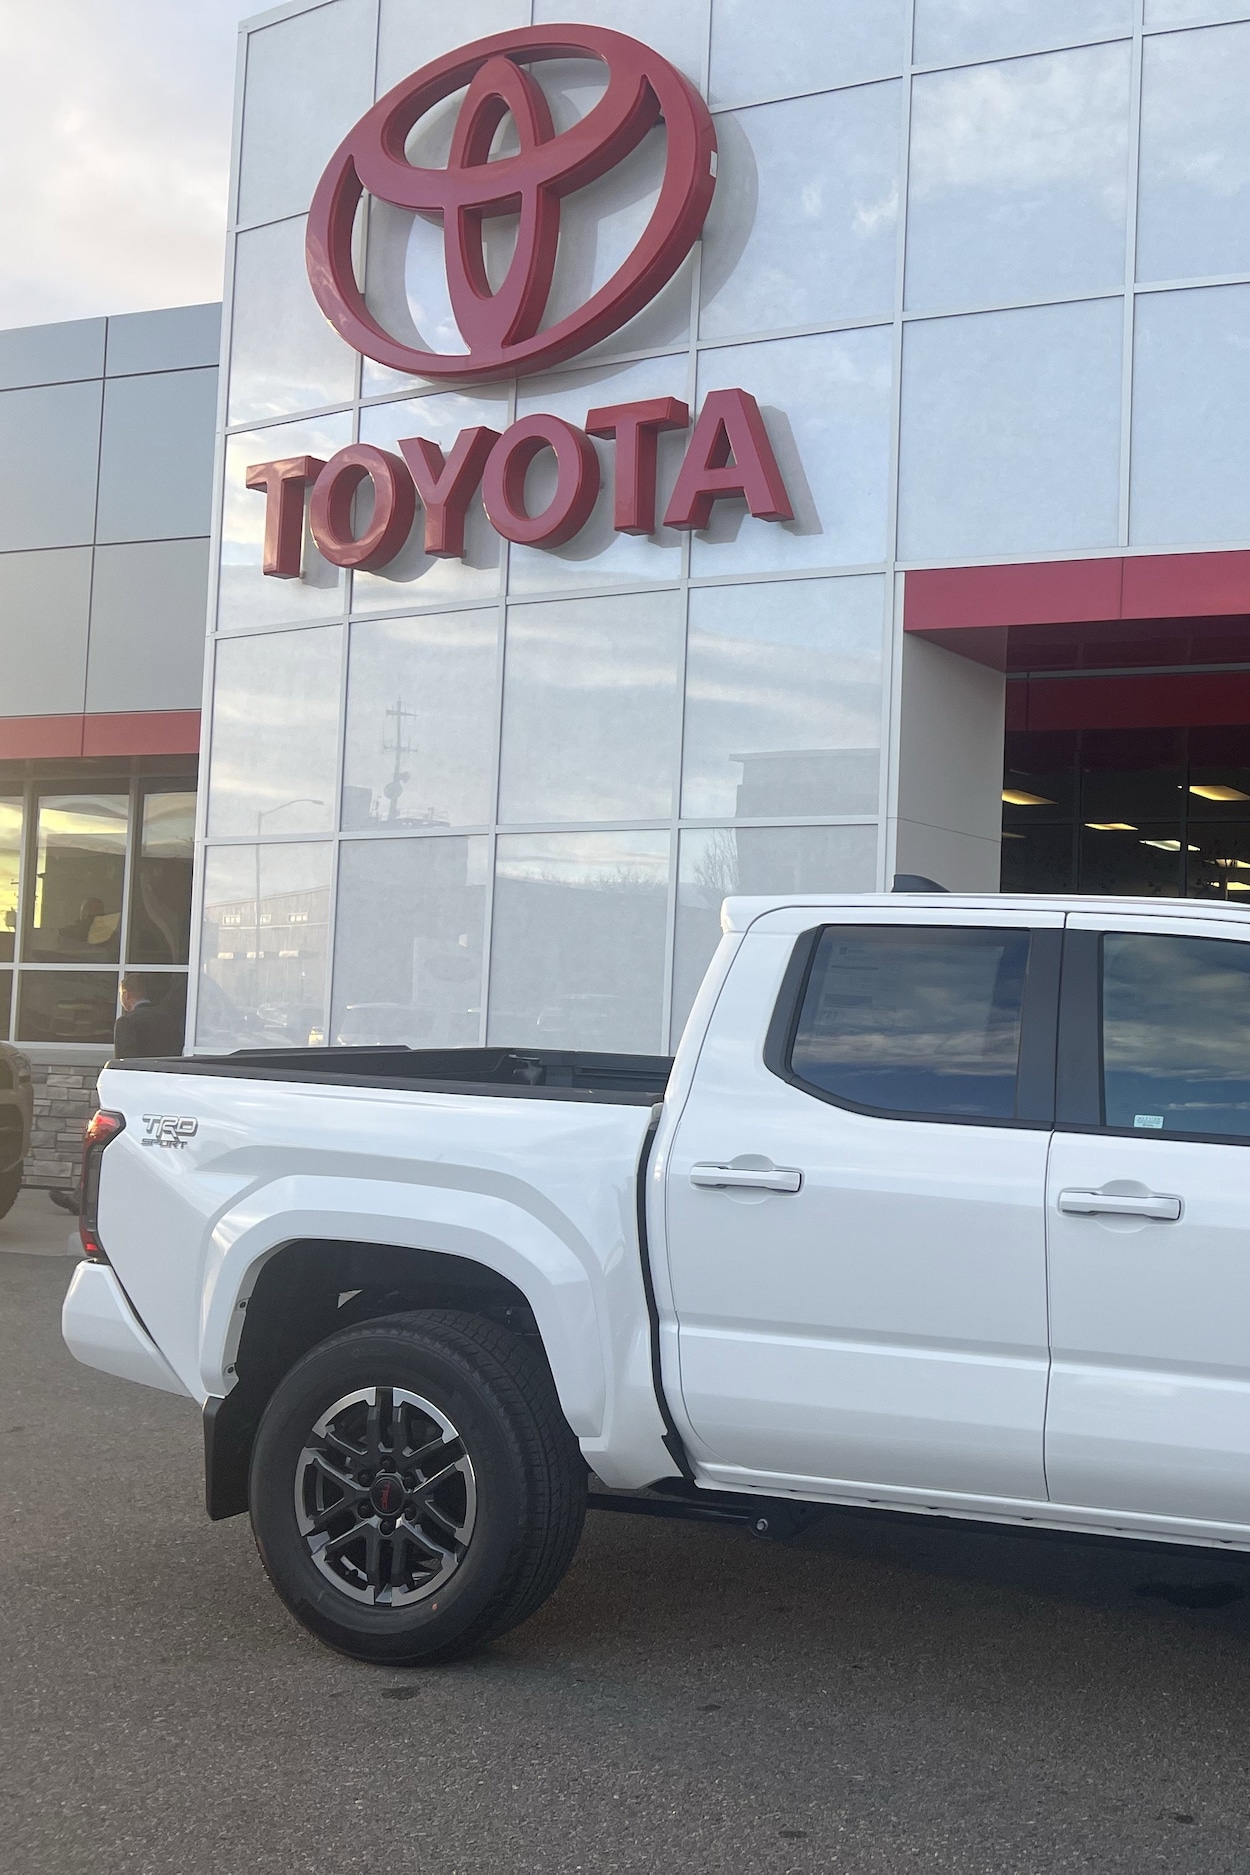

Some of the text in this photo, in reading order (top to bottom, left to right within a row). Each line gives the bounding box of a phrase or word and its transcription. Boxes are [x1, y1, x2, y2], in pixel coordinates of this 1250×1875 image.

[246, 388, 795, 578] TOYOTA
[142, 1113, 198, 1142] TRD
[141, 1138, 188, 1149] SPORT
